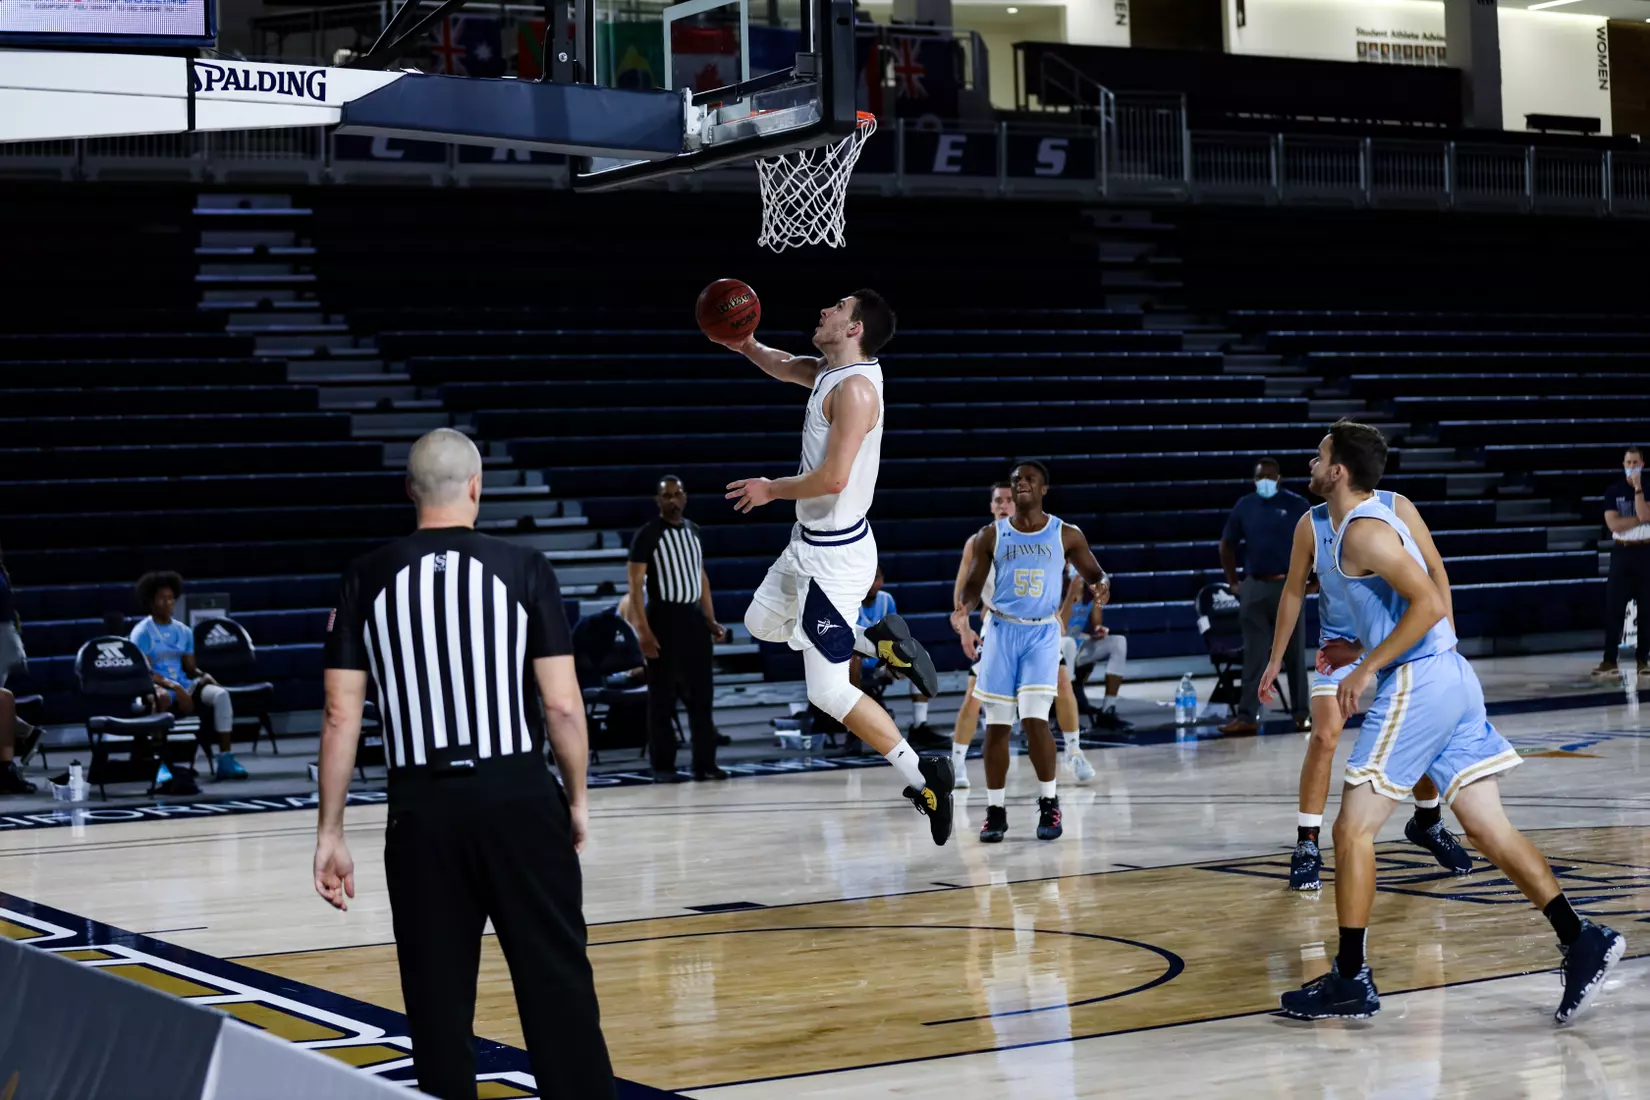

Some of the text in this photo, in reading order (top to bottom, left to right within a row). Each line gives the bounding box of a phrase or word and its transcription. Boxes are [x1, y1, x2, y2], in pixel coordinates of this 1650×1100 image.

[1596, 26, 1609, 91] WOMEN
[1003, 544, 1053, 561] HAWKS
[1014, 568, 1044, 597] 55
[94, 657, 134, 668] adidas
